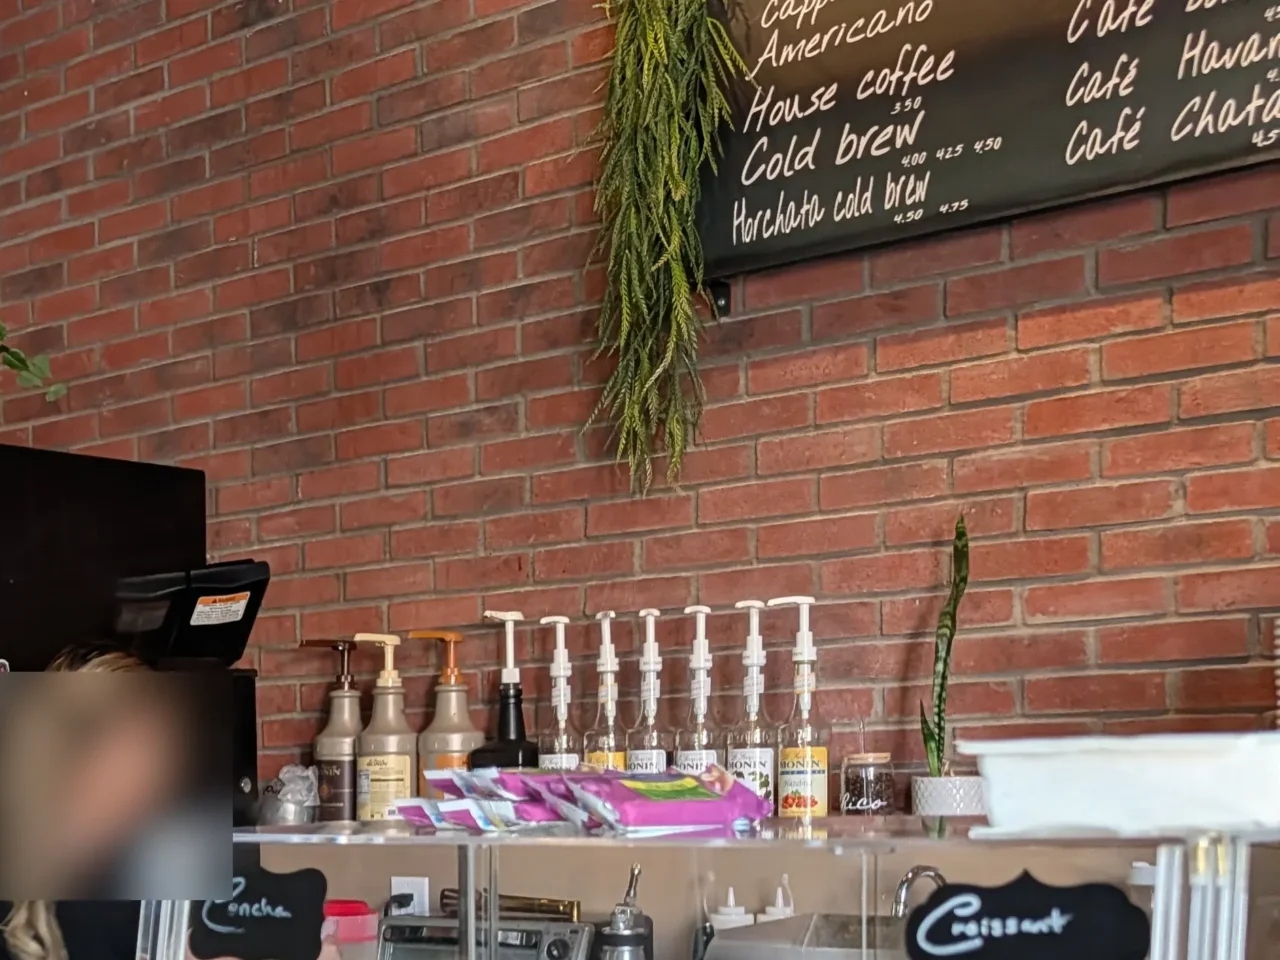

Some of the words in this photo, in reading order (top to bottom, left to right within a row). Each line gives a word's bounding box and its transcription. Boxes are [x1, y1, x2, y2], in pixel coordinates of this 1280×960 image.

[745, 0, 933, 80] Americano
[743, 82, 838, 134] House
[856, 43, 956, 100] coffee
[1066, 53, 1140, 107] Café
[740, 127, 821, 186] Cold
[835, 110, 922, 166] brew
[1065, 106, 1146, 165] Café
[732, 189, 824, 246] Horchata
[833, 176, 874, 222] cold
[884, 170, 930, 210] brew
[938, 199, 969, 214] 4.75
